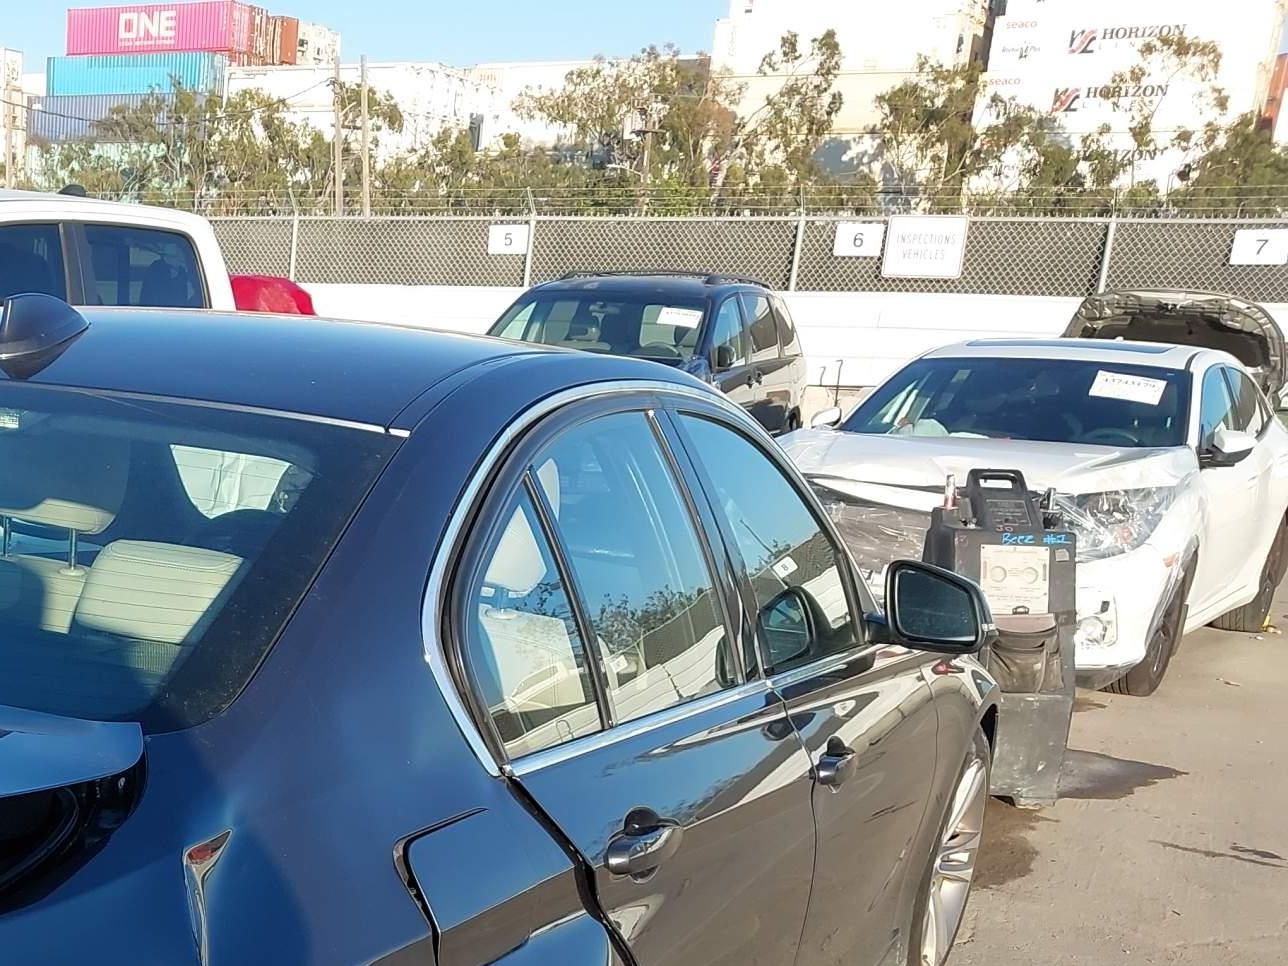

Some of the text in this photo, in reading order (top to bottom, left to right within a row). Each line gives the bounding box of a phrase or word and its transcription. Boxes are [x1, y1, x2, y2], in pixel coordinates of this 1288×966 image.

[119, 10, 176, 38] ONE
[1006, 20, 1038, 29] seaco
[1101, 24, 1187, 40] HORIZON
[989, 76, 1021, 86] seaco
[1085, 84, 1169, 99] HORIZON
[504, 232, 513, 246] 5
[853, 232, 865, 248] 6
[896, 232, 957, 245] INSPECTIONS
[1256, 239, 1269, 255] 7
[902, 249, 946, 260] VEHICLES
